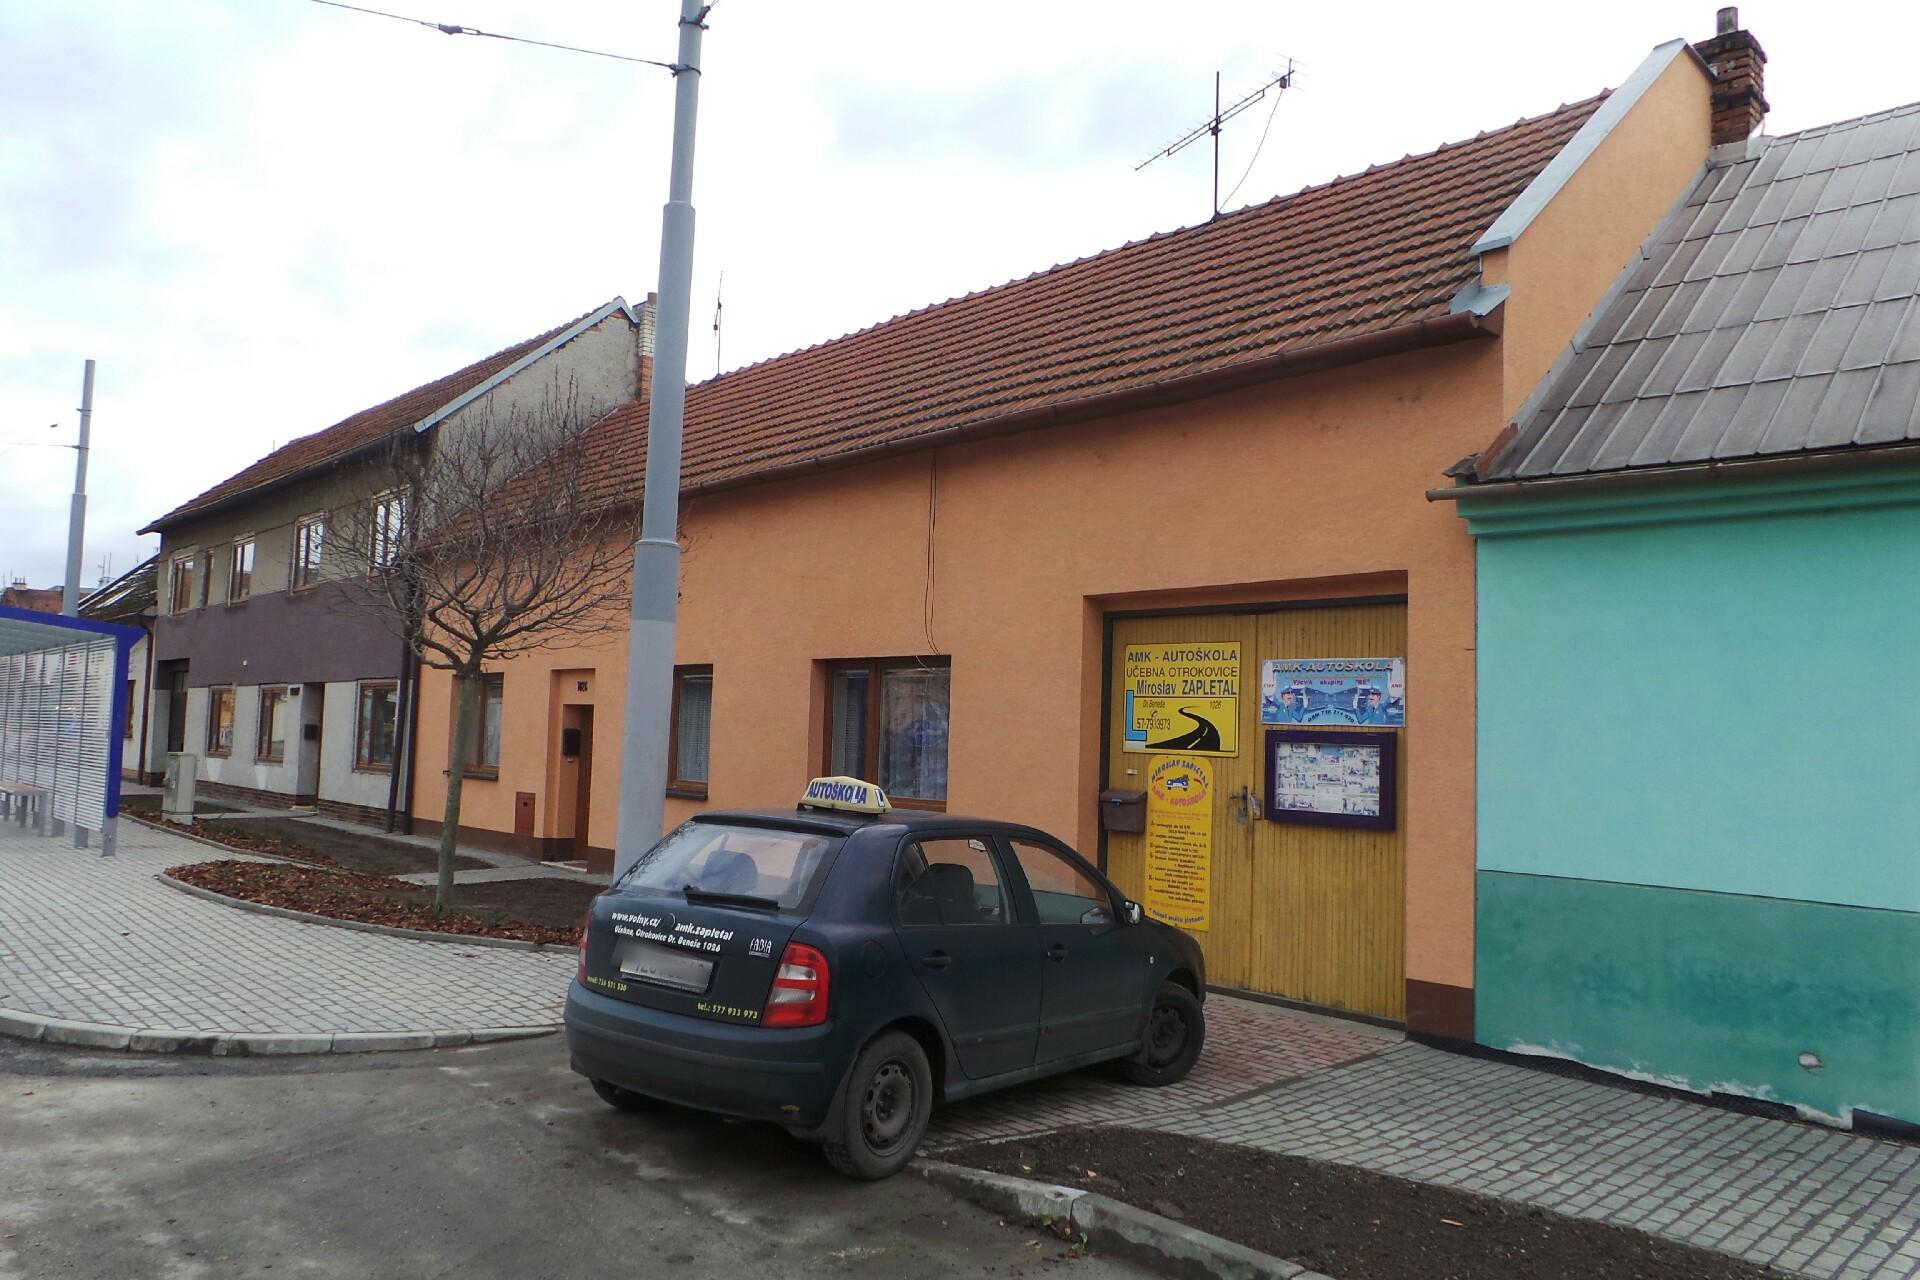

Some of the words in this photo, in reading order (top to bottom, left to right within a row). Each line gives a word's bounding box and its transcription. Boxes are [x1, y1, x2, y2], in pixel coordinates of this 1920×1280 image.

[1127, 651, 1152, 662] AMK
[1162, 647, 1238, 662] AUTOŠKOLA
[1126, 665, 1165, 678] UČEBNA
[1168, 666, 1238, 678] OTROKOVICE
[1136, 680, 1177, 695] Miroslav
[1181, 679, 1237, 695] ZAPLETAL
[675, 922, 734, 941] amk.zapletal
[635, 928, 667, 942] Otrokovice
[667, 934, 676, 944] Dr.
[703, 941, 721, 953] 1026
[749, 937, 772, 952] FABIA
[712, 1004, 726, 1014] 577
[743, 1009, 758, 1019] 973
